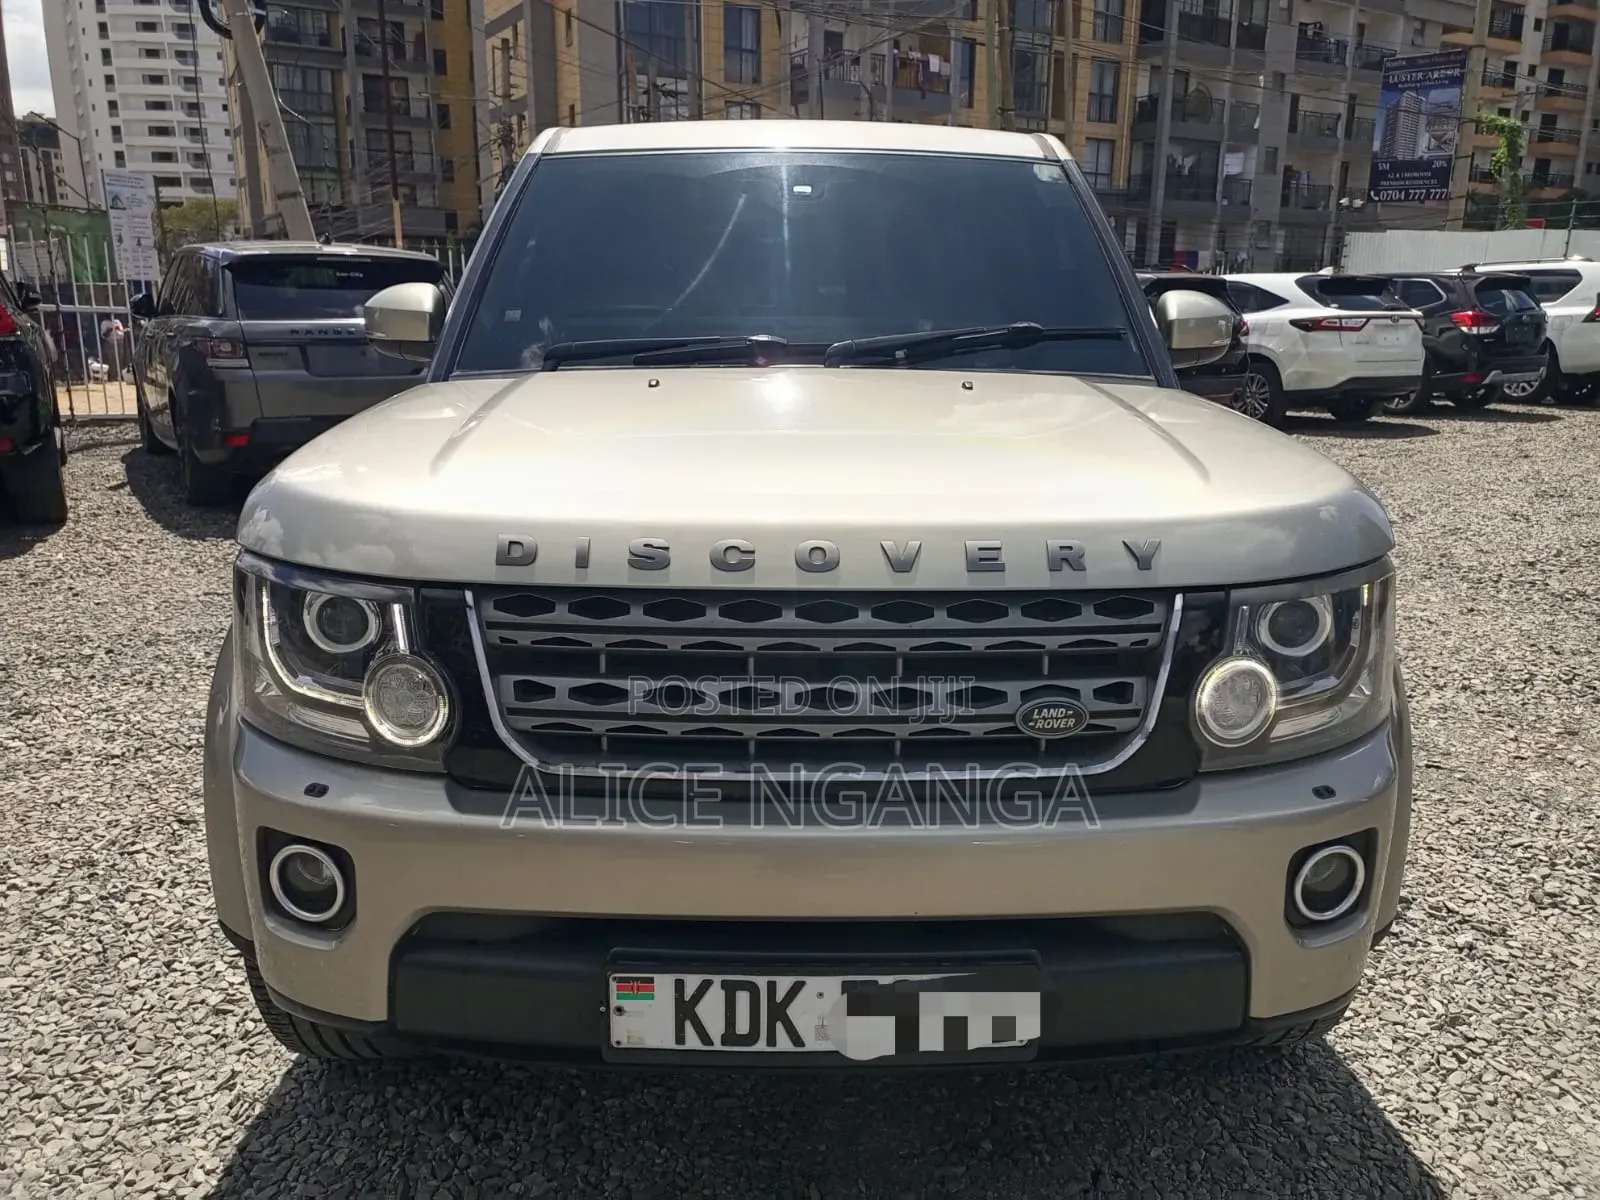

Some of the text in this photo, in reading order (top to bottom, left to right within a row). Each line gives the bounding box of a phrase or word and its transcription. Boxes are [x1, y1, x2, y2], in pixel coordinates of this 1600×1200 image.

[1431, 160, 1448, 168] 20%
[1380, 188, 1448, 201] 0704 777 777
[290, 326, 357, 336] RANGE
[496, 533, 1164, 574] DISCOVERY
[1032, 708, 1067, 719] LAND
[1035, 718, 1076, 729] ROVER
[674, 978, 807, 1048] KDK
